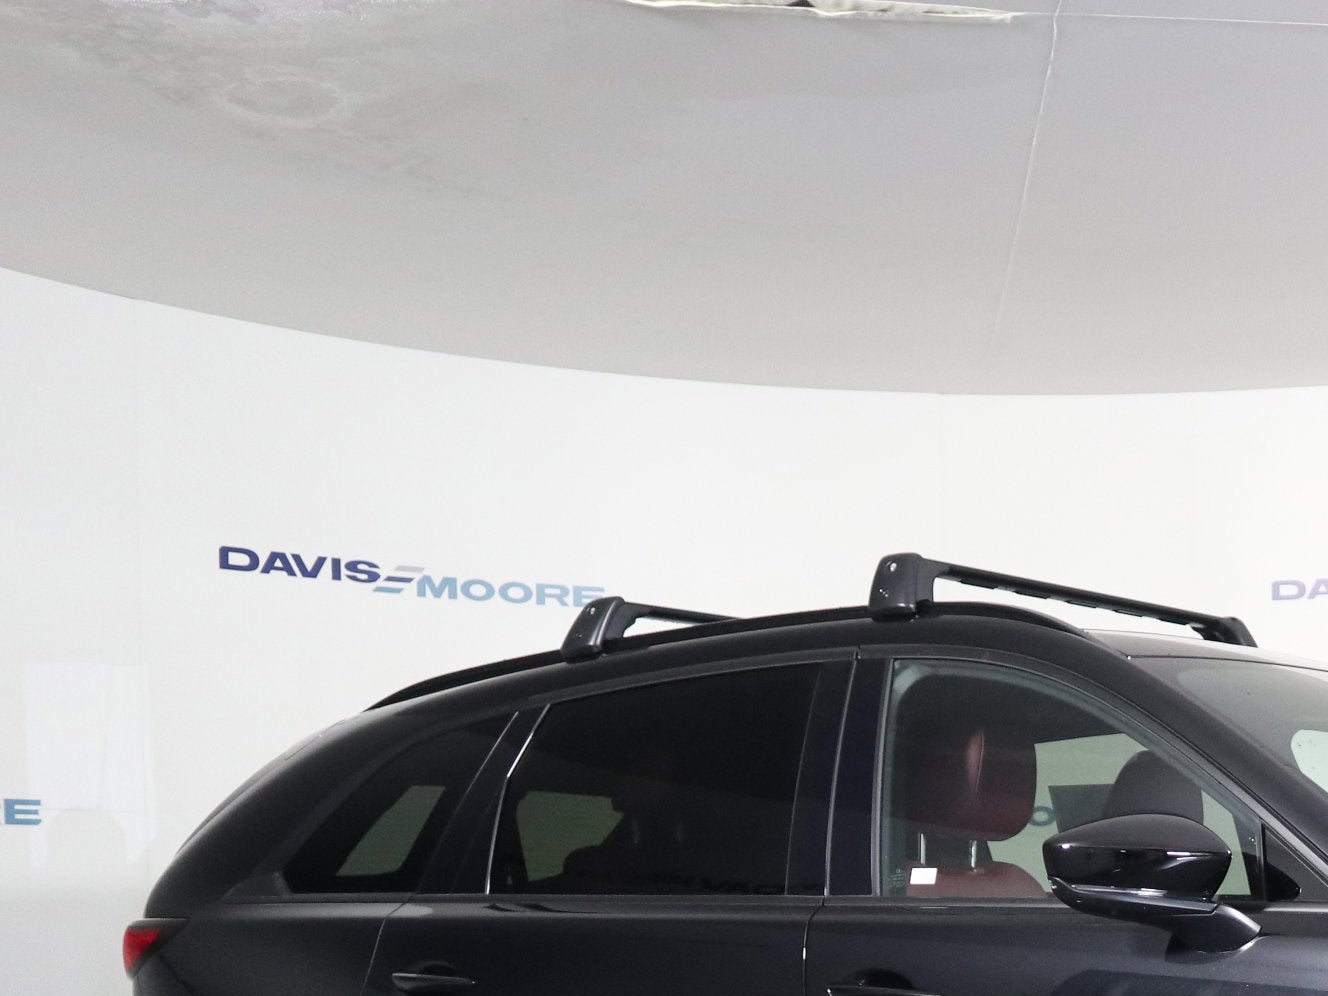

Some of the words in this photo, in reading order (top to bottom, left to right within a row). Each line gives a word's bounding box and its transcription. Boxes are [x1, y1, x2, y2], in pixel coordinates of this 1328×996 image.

[219, 545, 381, 583] DAVIS
[416, 574, 606, 608] MOORE
[0, 798, 42, 826] E
